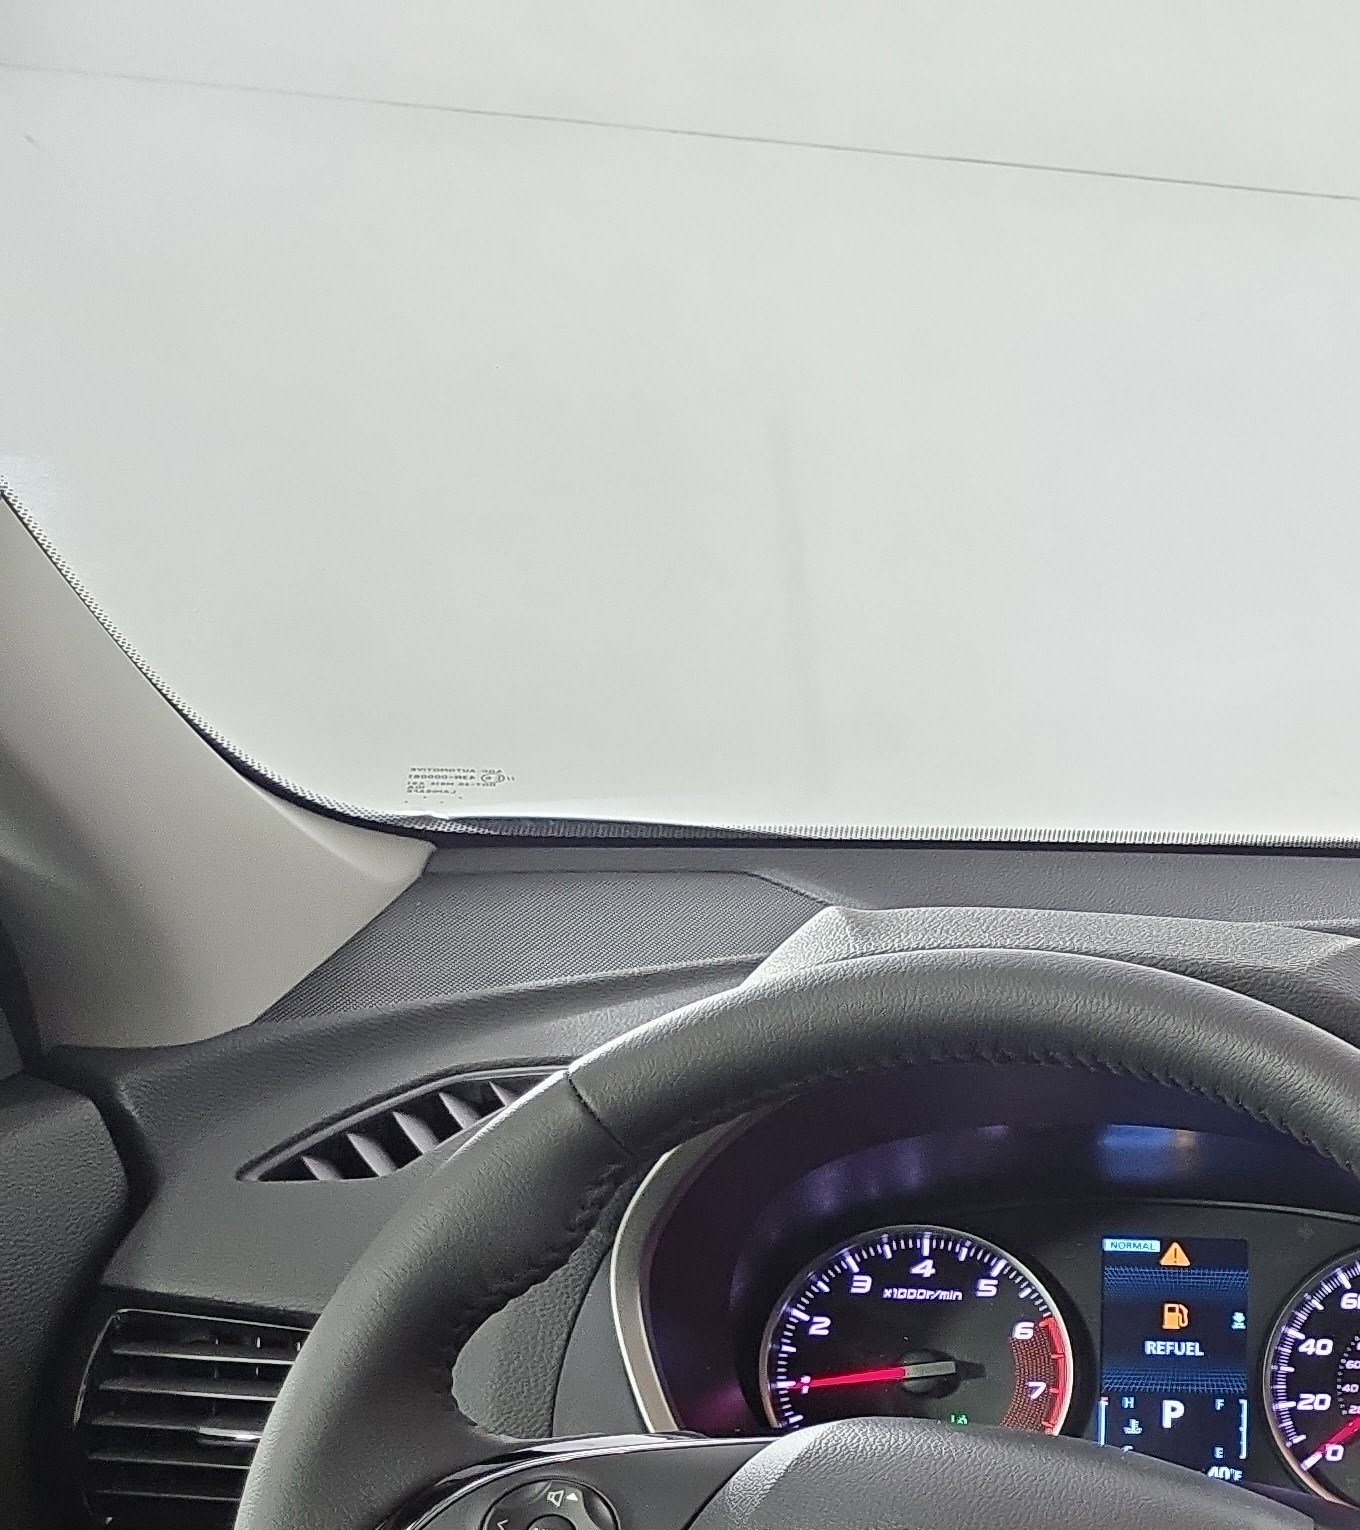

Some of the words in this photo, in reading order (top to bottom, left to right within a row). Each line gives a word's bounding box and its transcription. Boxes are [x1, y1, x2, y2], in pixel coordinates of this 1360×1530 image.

[1110, 1241, 1156, 1251] NORMAL
[911, 1259, 936, 1278] 4
[849, 1275, 873, 1294] 3
[975, 1278, 1000, 1297] 5
[808, 1316, 832, 1336] 2
[1012, 1321, 1034, 1340] 6
[1144, 1340, 1205, 1356] REFUEL
[1299, 1338, 1333, 1355] 40
[1026, 1381, 1047, 1400] 7
[1341, 1383, 1360, 1393] 40
[1122, 1397, 1135, 1409] H
[1215, 1398, 1225, 1410] F
[1296, 1394, 1331, 1411] 20
[1162, 1400, 1185, 1428] P
[1214, 1447, 1224, 1460] E
[1325, 1445, 1344, 1461] 0
